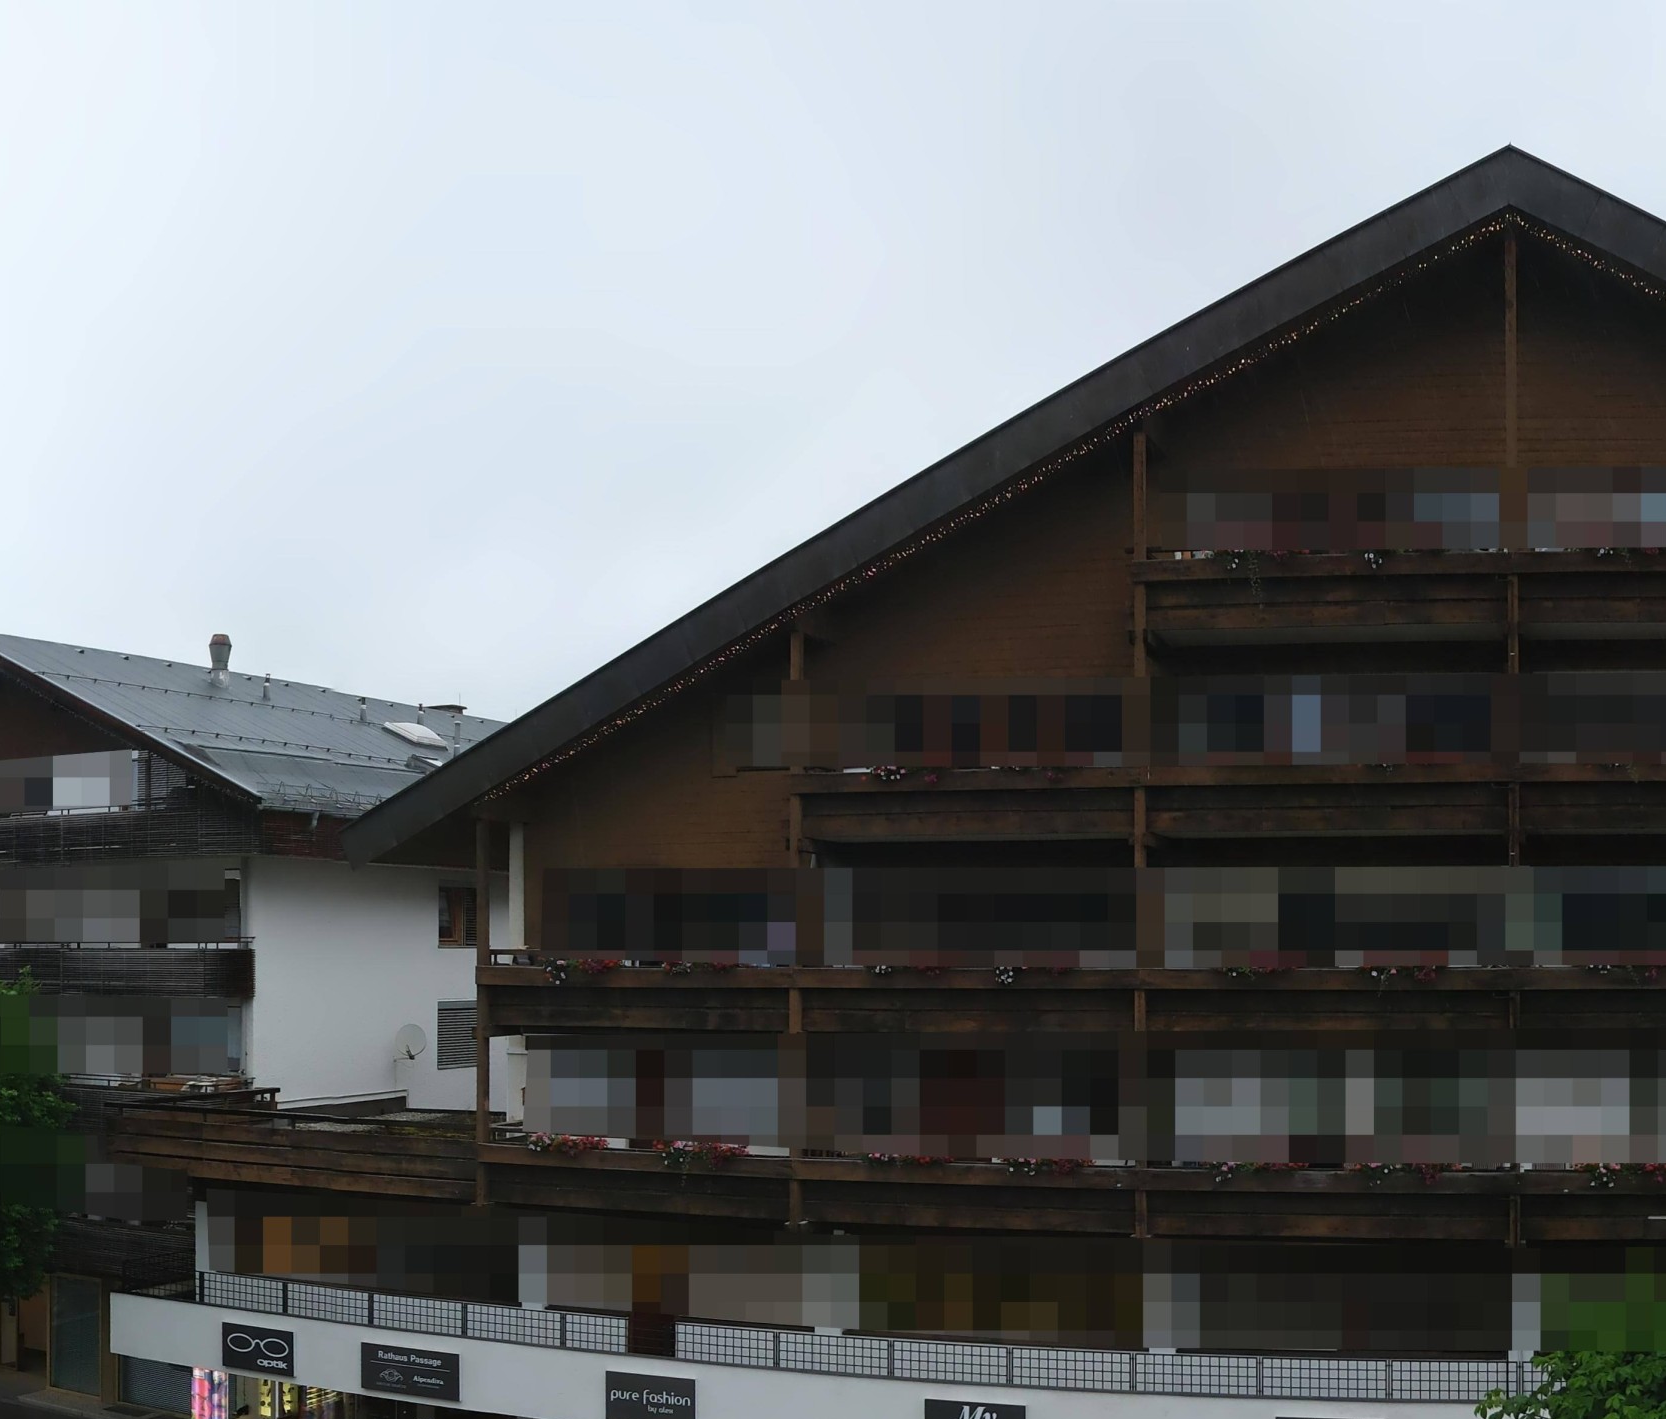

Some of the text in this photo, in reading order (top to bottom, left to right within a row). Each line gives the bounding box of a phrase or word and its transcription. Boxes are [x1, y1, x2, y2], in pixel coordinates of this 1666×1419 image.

[257, 1358, 288, 1370] optik
[378, 1350, 442, 1367] Rathaus Passage
[610, 1388, 639, 1405] pure
[647, 1404, 658, 1414] by
